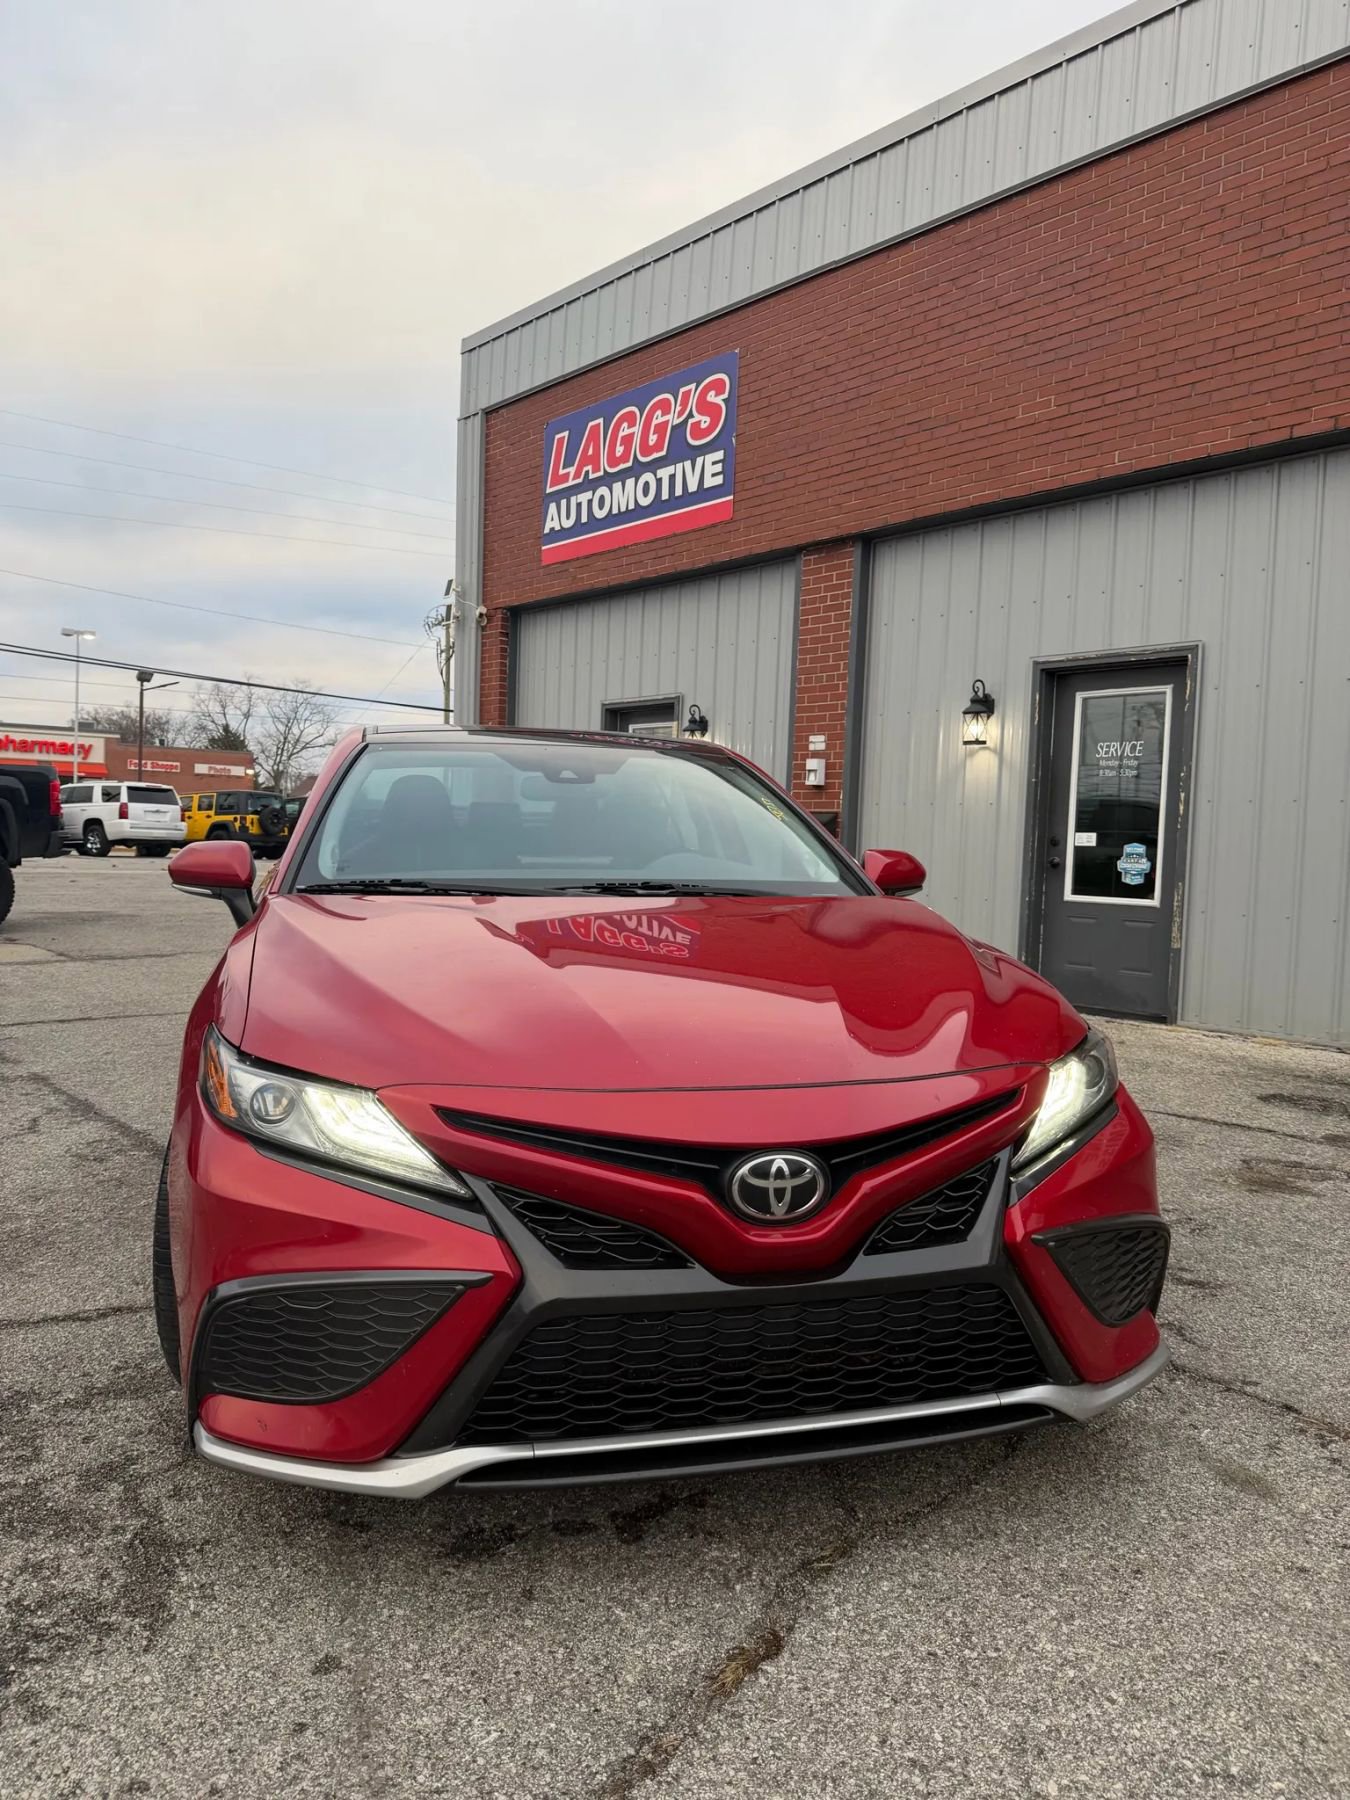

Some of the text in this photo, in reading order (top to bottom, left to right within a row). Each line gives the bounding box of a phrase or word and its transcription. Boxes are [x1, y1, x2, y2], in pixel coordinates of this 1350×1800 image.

[546, 373, 730, 494] LAGG'S
[543, 450, 725, 534] AUTOMOTIVE
[0, 735, 93, 760] harmacy
[1096, 741, 1144, 757] SERVICE
[128, 760, 148, 769] Fod
[1099, 759, 1119, 768] Monday
[1122, 759, 1138, 768] Friday
